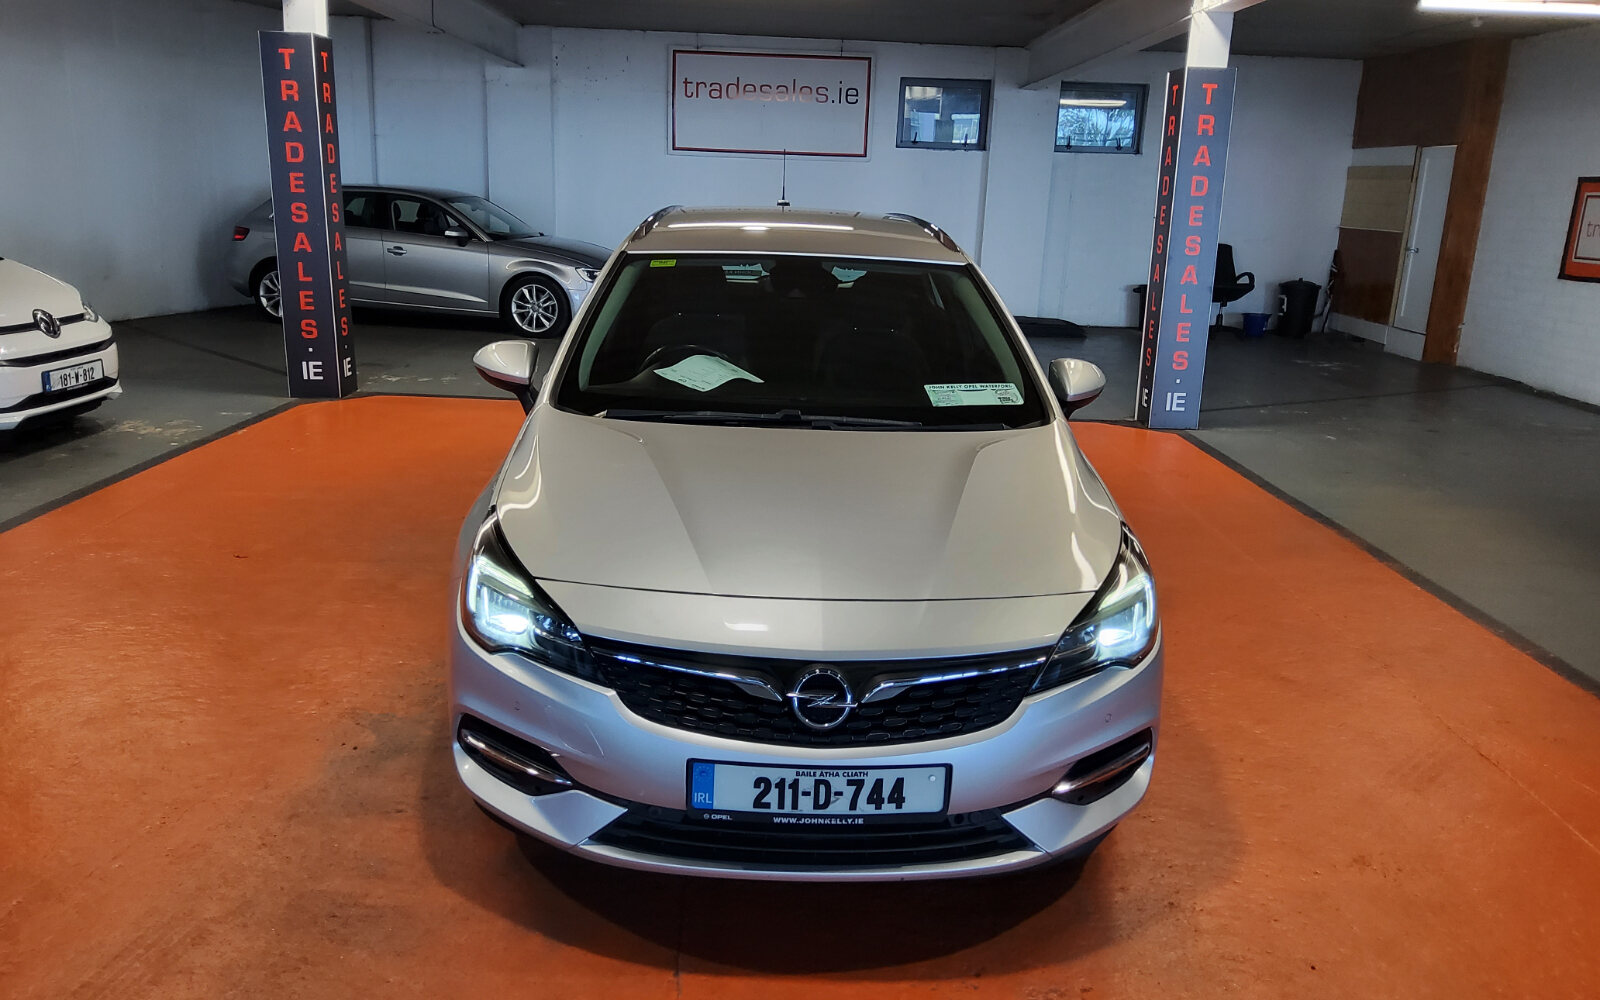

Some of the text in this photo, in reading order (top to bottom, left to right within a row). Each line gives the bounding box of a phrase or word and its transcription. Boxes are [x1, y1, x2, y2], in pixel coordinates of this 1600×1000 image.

[683, 77, 859, 105] tradesales.ie
[278, 48, 324, 381] TRADESALES.IE
[1587, 220, 1600, 237] tr
[1165, 83, 1218, 412] TRADESALES.IE
[60, 366, 95, 388] 181-W-812
[694, 792, 712, 804] IRL
[752, 777, 906, 811] 211-D-744
[711, 813, 733, 821] OPEL
[773, 816, 864, 825] WWW.JOHNKELLY.IE
